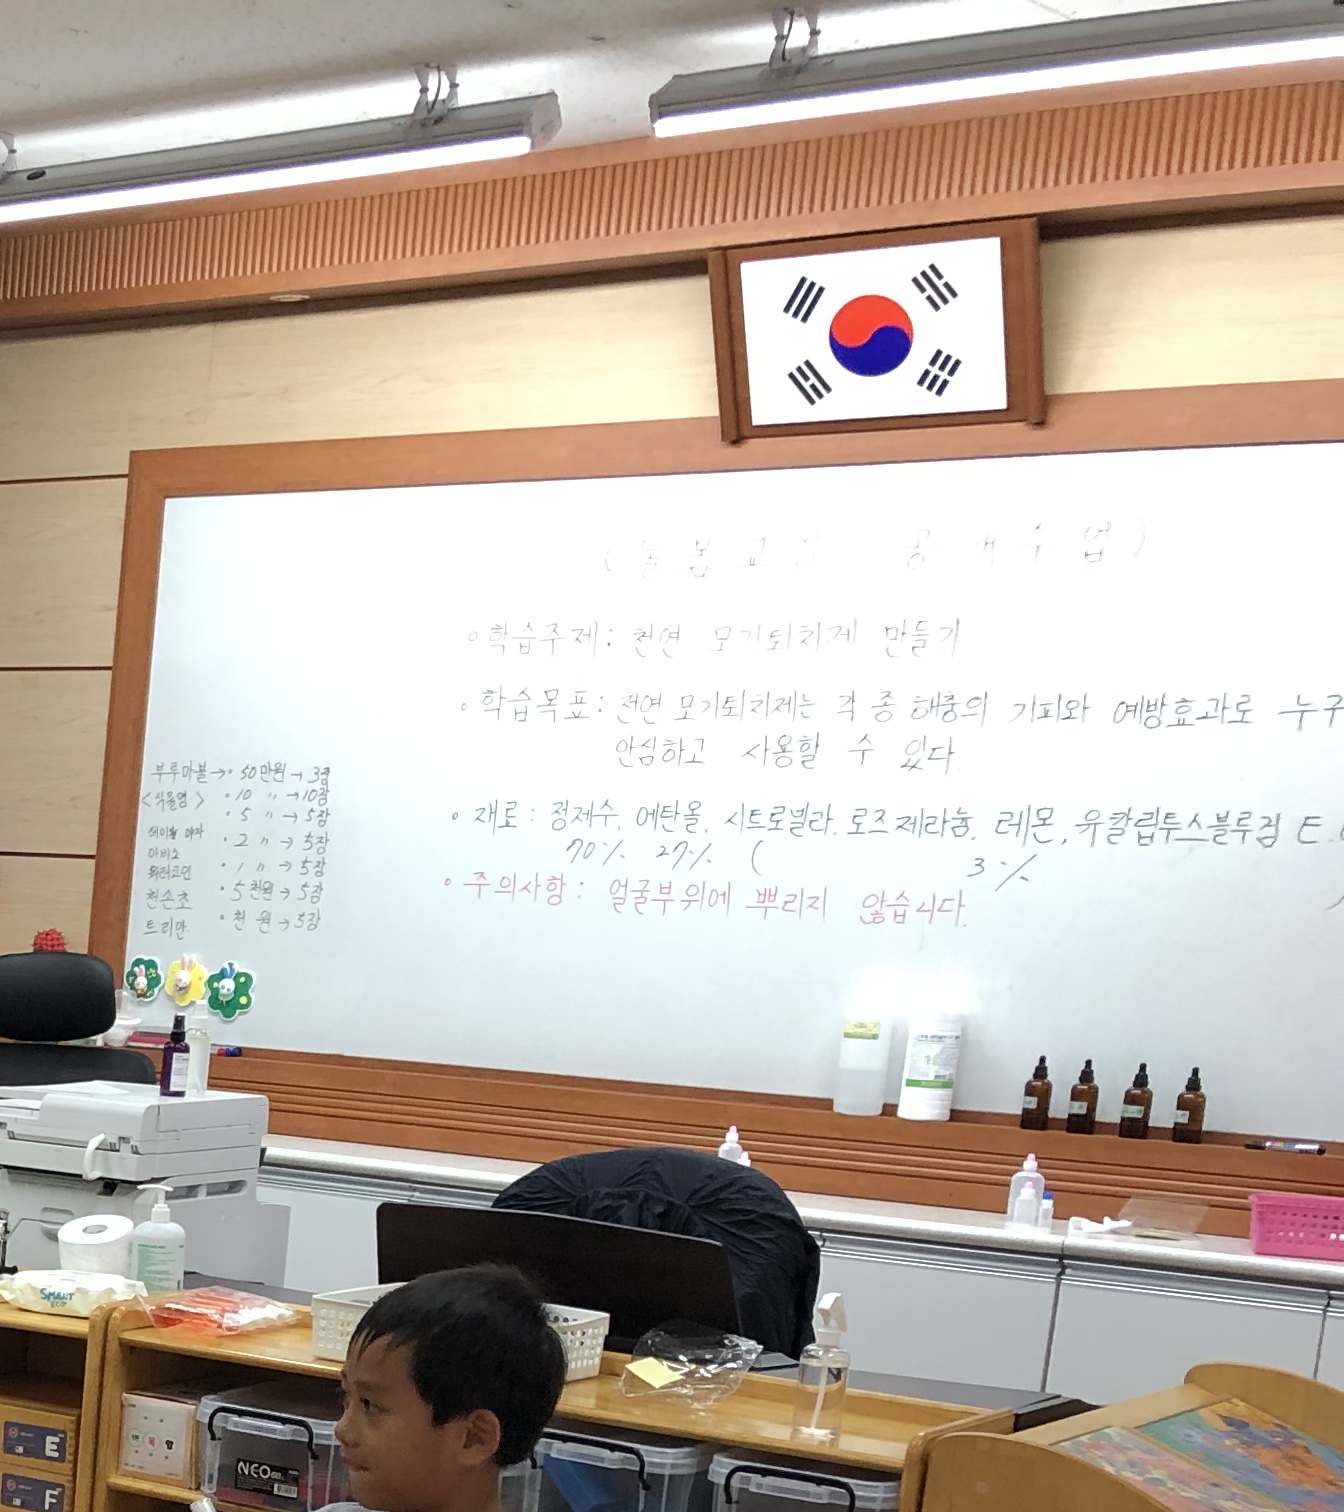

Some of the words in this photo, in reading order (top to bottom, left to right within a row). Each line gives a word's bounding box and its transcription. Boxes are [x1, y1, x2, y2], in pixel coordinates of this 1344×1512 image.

[632, 623, 682, 659] 천연
[710, 620, 858, 652] 모기퇴치제
[885, 618, 961, 658] 만들기
[615, 692, 662, 725] 천연
[674, 689, 816, 724] 모기퇴치제는
[911, 690, 989, 727] 해충의
[1009, 692, 1092, 726] 기피와
[1112, 692, 1256, 730] 예방효과로
[615, 735, 706, 768] 안심하고
[741, 731, 820, 770] 사용할
[848, 733, 876, 766] 수
[234, 788, 253, 801] 10
[240, 807, 252, 822] 5
[304, 807, 331, 828] 5장
[232, 832, 249, 848] 2
[301, 830, 330, 855] 5장
[566, 838, 626, 866] 70%
[298, 855, 327, 878] 5장
[296, 881, 324, 905] 5장
[609, 877, 732, 917] 얼굴부위에
[745, 886, 827, 920] 뿌리지
[45, 1435, 61, 1458] E
[237, 1461, 271, 1479] NEO
[44, 1489, 59, 1511] F
